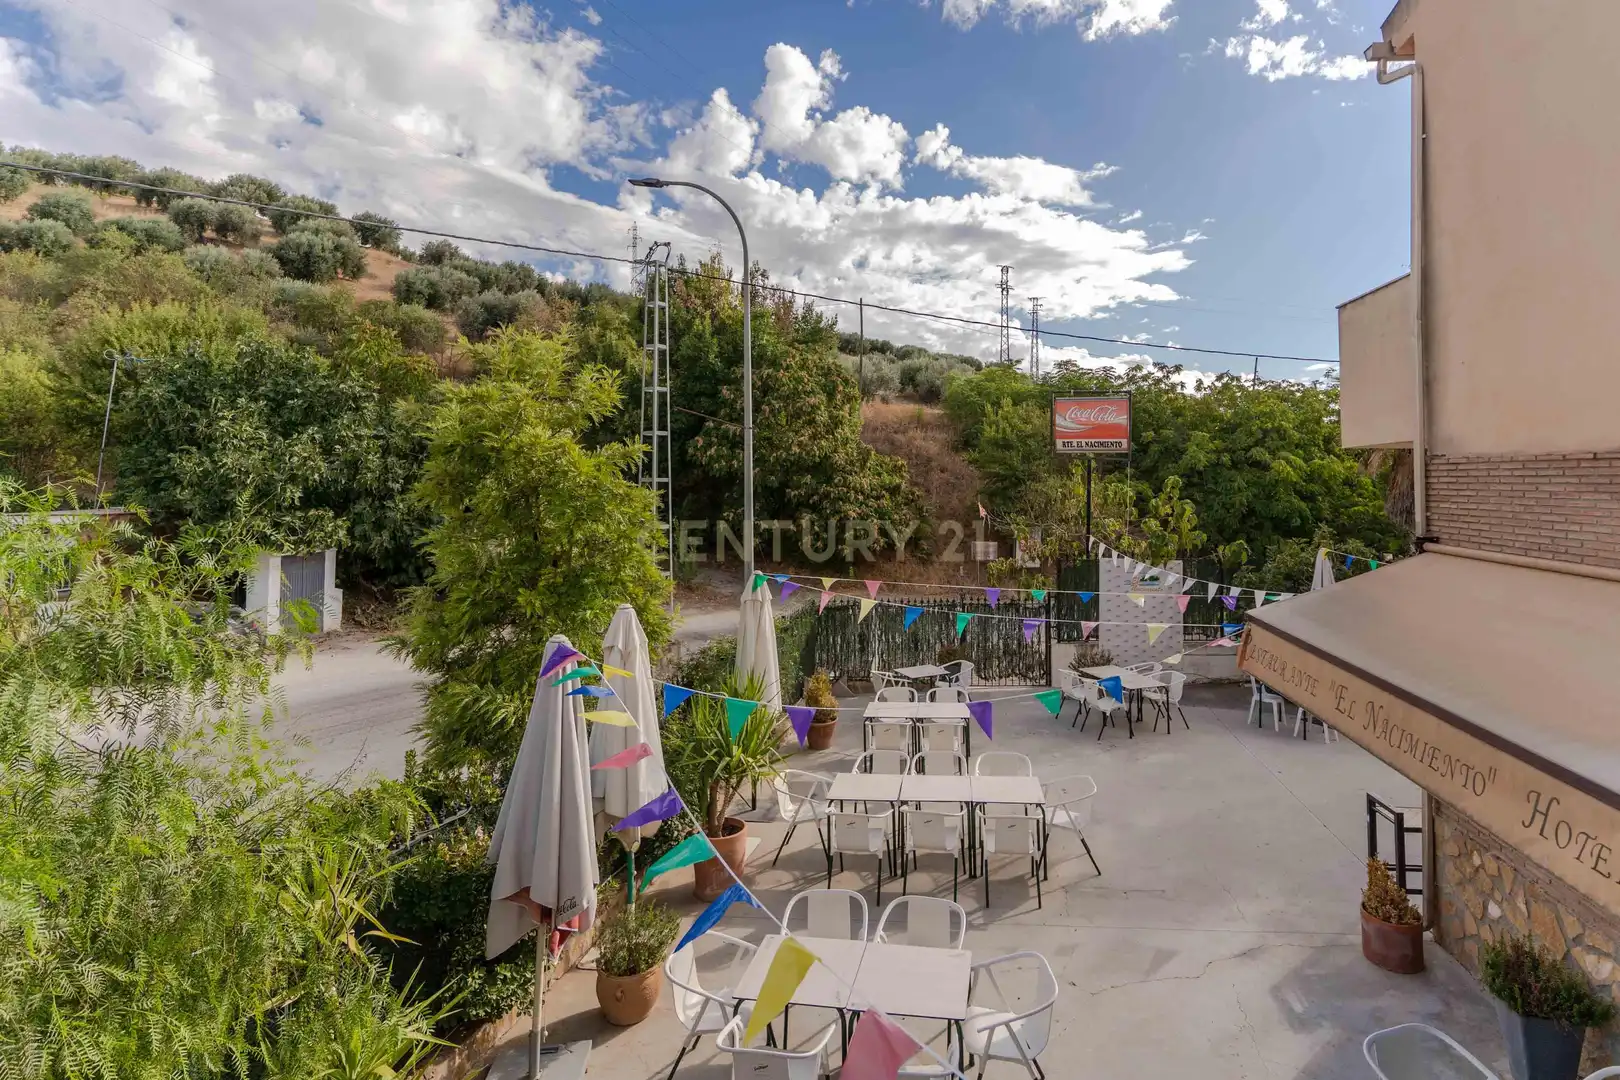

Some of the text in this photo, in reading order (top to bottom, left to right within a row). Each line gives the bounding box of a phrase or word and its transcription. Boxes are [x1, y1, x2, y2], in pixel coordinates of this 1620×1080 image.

[1076, 440, 1084, 449] EL
[1085, 440, 1123, 449] NACIMIENTO
[1521, 789, 1620, 885] HOTE
